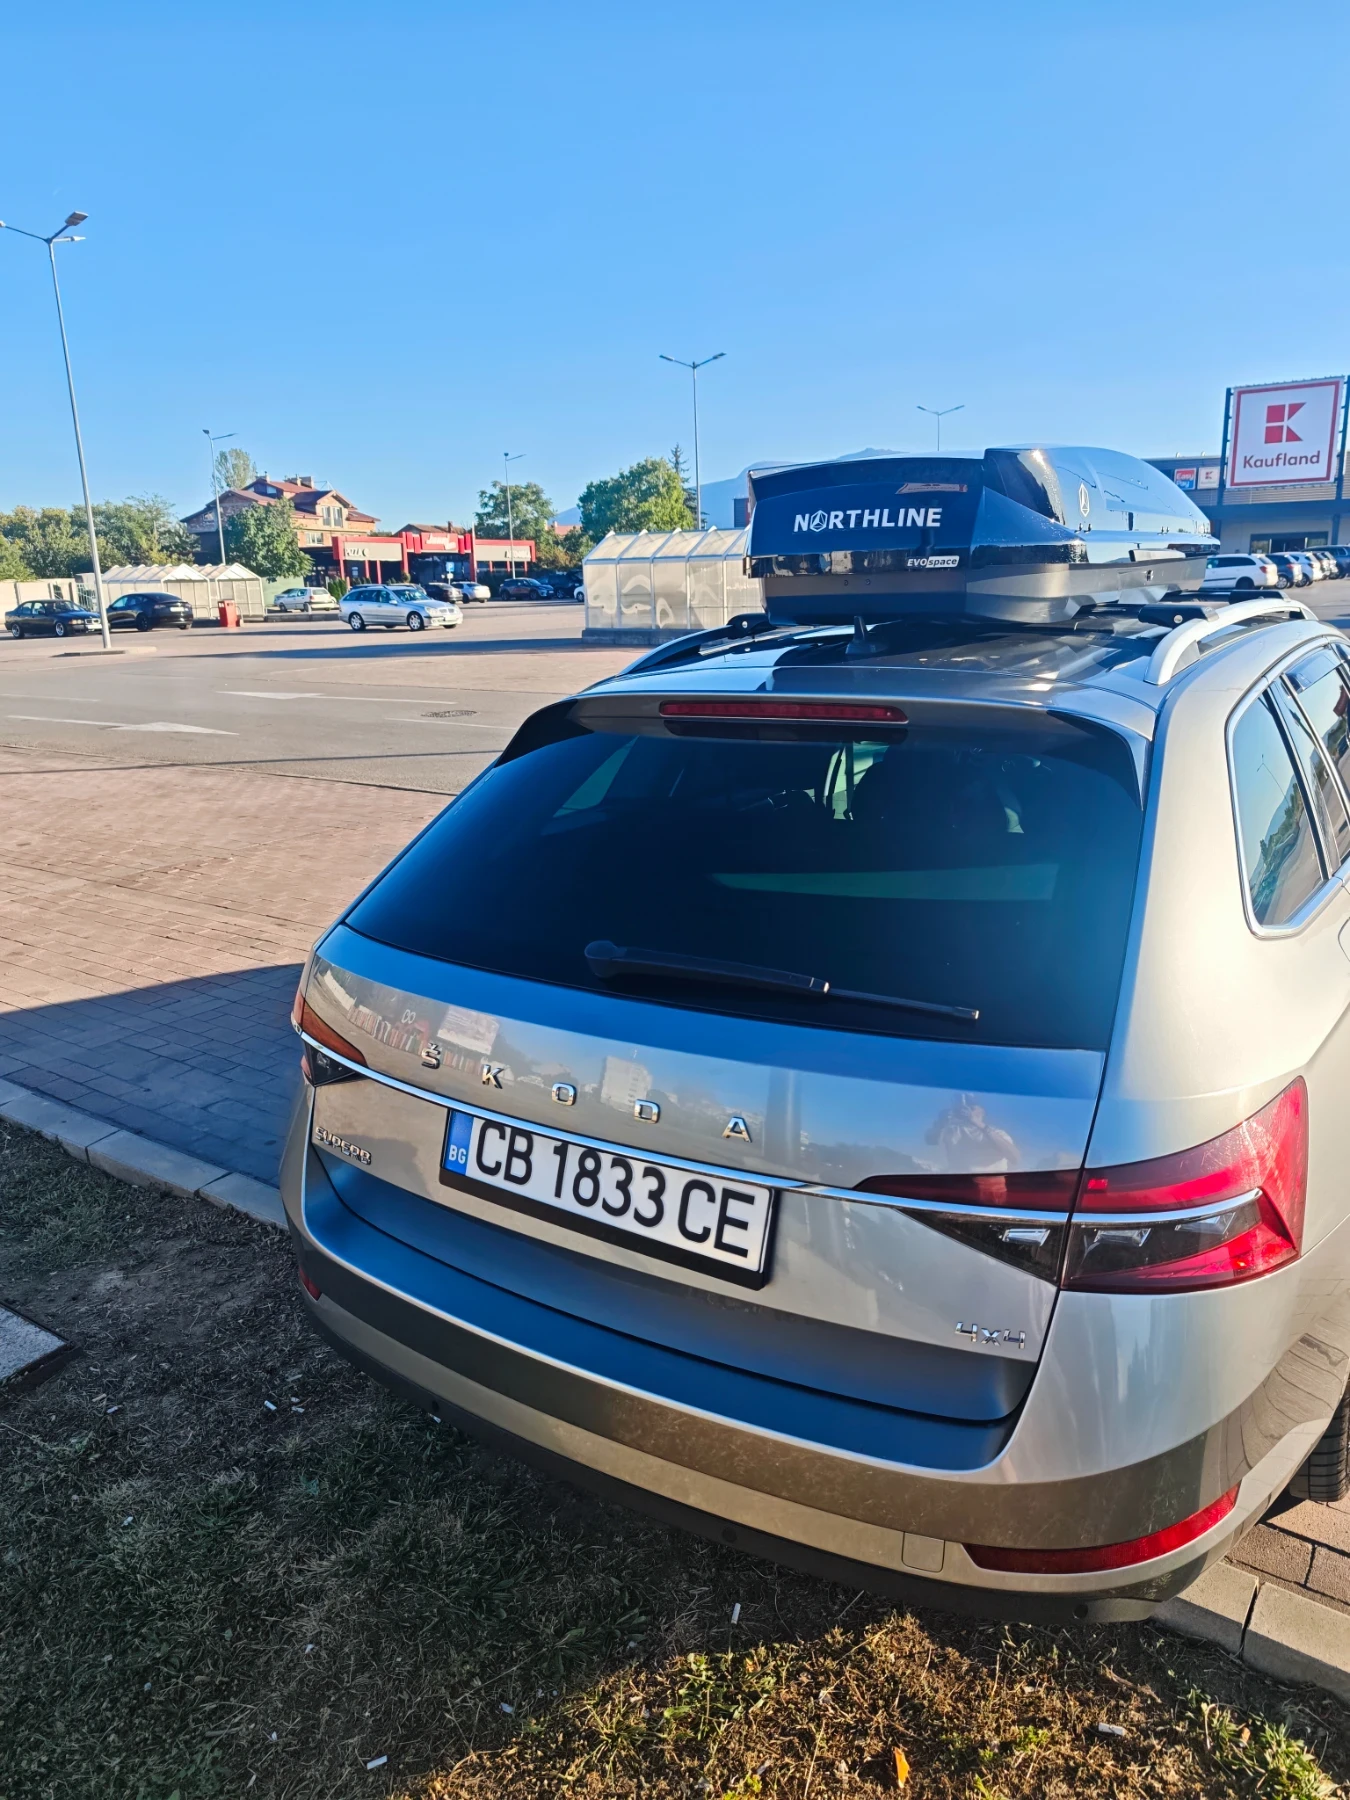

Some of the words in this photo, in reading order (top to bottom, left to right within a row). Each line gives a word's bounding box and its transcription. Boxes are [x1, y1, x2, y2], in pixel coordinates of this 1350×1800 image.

[1243, 450, 1320, 468] Kaufland
[794, 507, 942, 533] NORTHLINE
[421, 1042, 752, 1142] ŠKODA
[315, 1126, 371, 1165] SUPERB
[448, 1145, 466, 1165] BG
[476, 1119, 534, 1185] CB
[553, 1141, 666, 1227] 1833
[678, 1179, 755, 1258] CE
[955, 1322, 1026, 1349] 4x4
